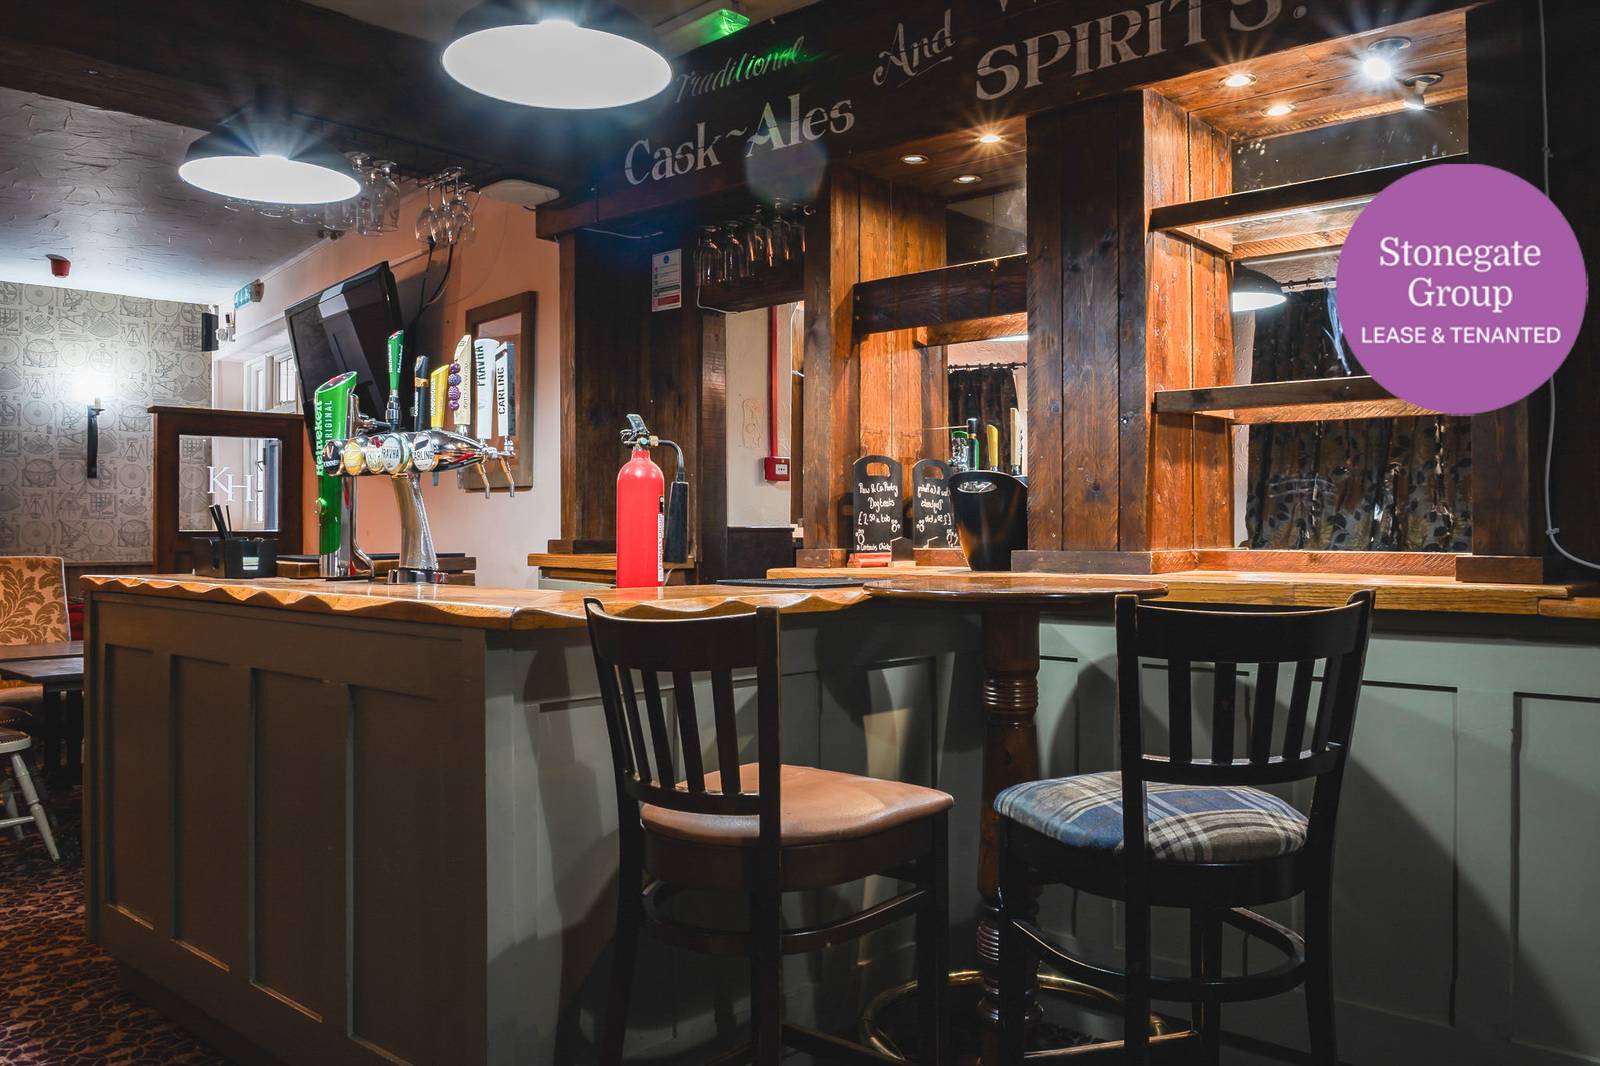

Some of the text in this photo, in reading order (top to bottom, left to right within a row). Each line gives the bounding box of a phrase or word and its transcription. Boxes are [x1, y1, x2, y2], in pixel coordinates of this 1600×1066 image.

[873, 8, 955, 86] And
[497, 367, 505, 415] CARLING
[314, 400, 324, 476] Heineken
[324, 400, 333, 438] RIGINAL
[207, 465, 255, 502] KH
